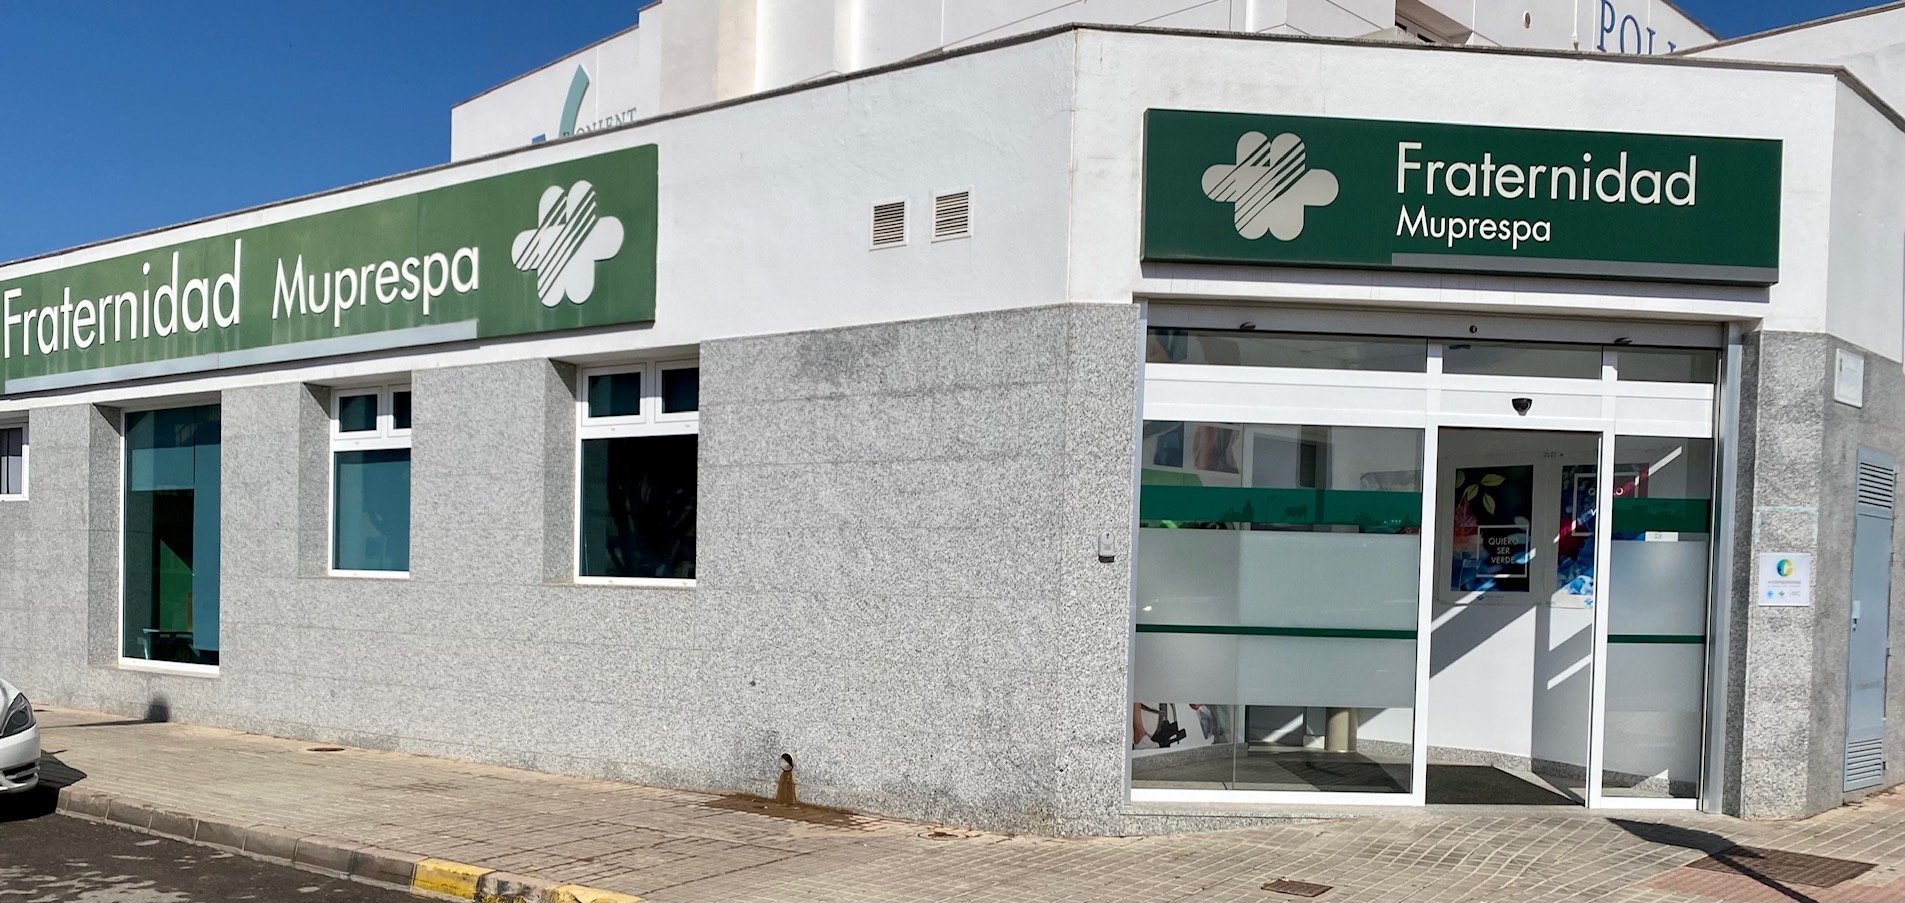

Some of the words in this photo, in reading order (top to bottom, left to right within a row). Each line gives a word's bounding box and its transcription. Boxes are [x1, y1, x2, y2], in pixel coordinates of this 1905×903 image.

[562, 107, 637, 136] NIENT
[1397, 141, 1697, 207] Fraternidad
[1396, 204, 1551, 250] Muprespa
[3, 238, 242, 359] Fraternidad
[271, 246, 479, 328] Muprespa
[1488, 537, 1519, 545] QUIERO
[1496, 546, 1511, 555] SER
[1491, 556, 1516, 564] VERDE
